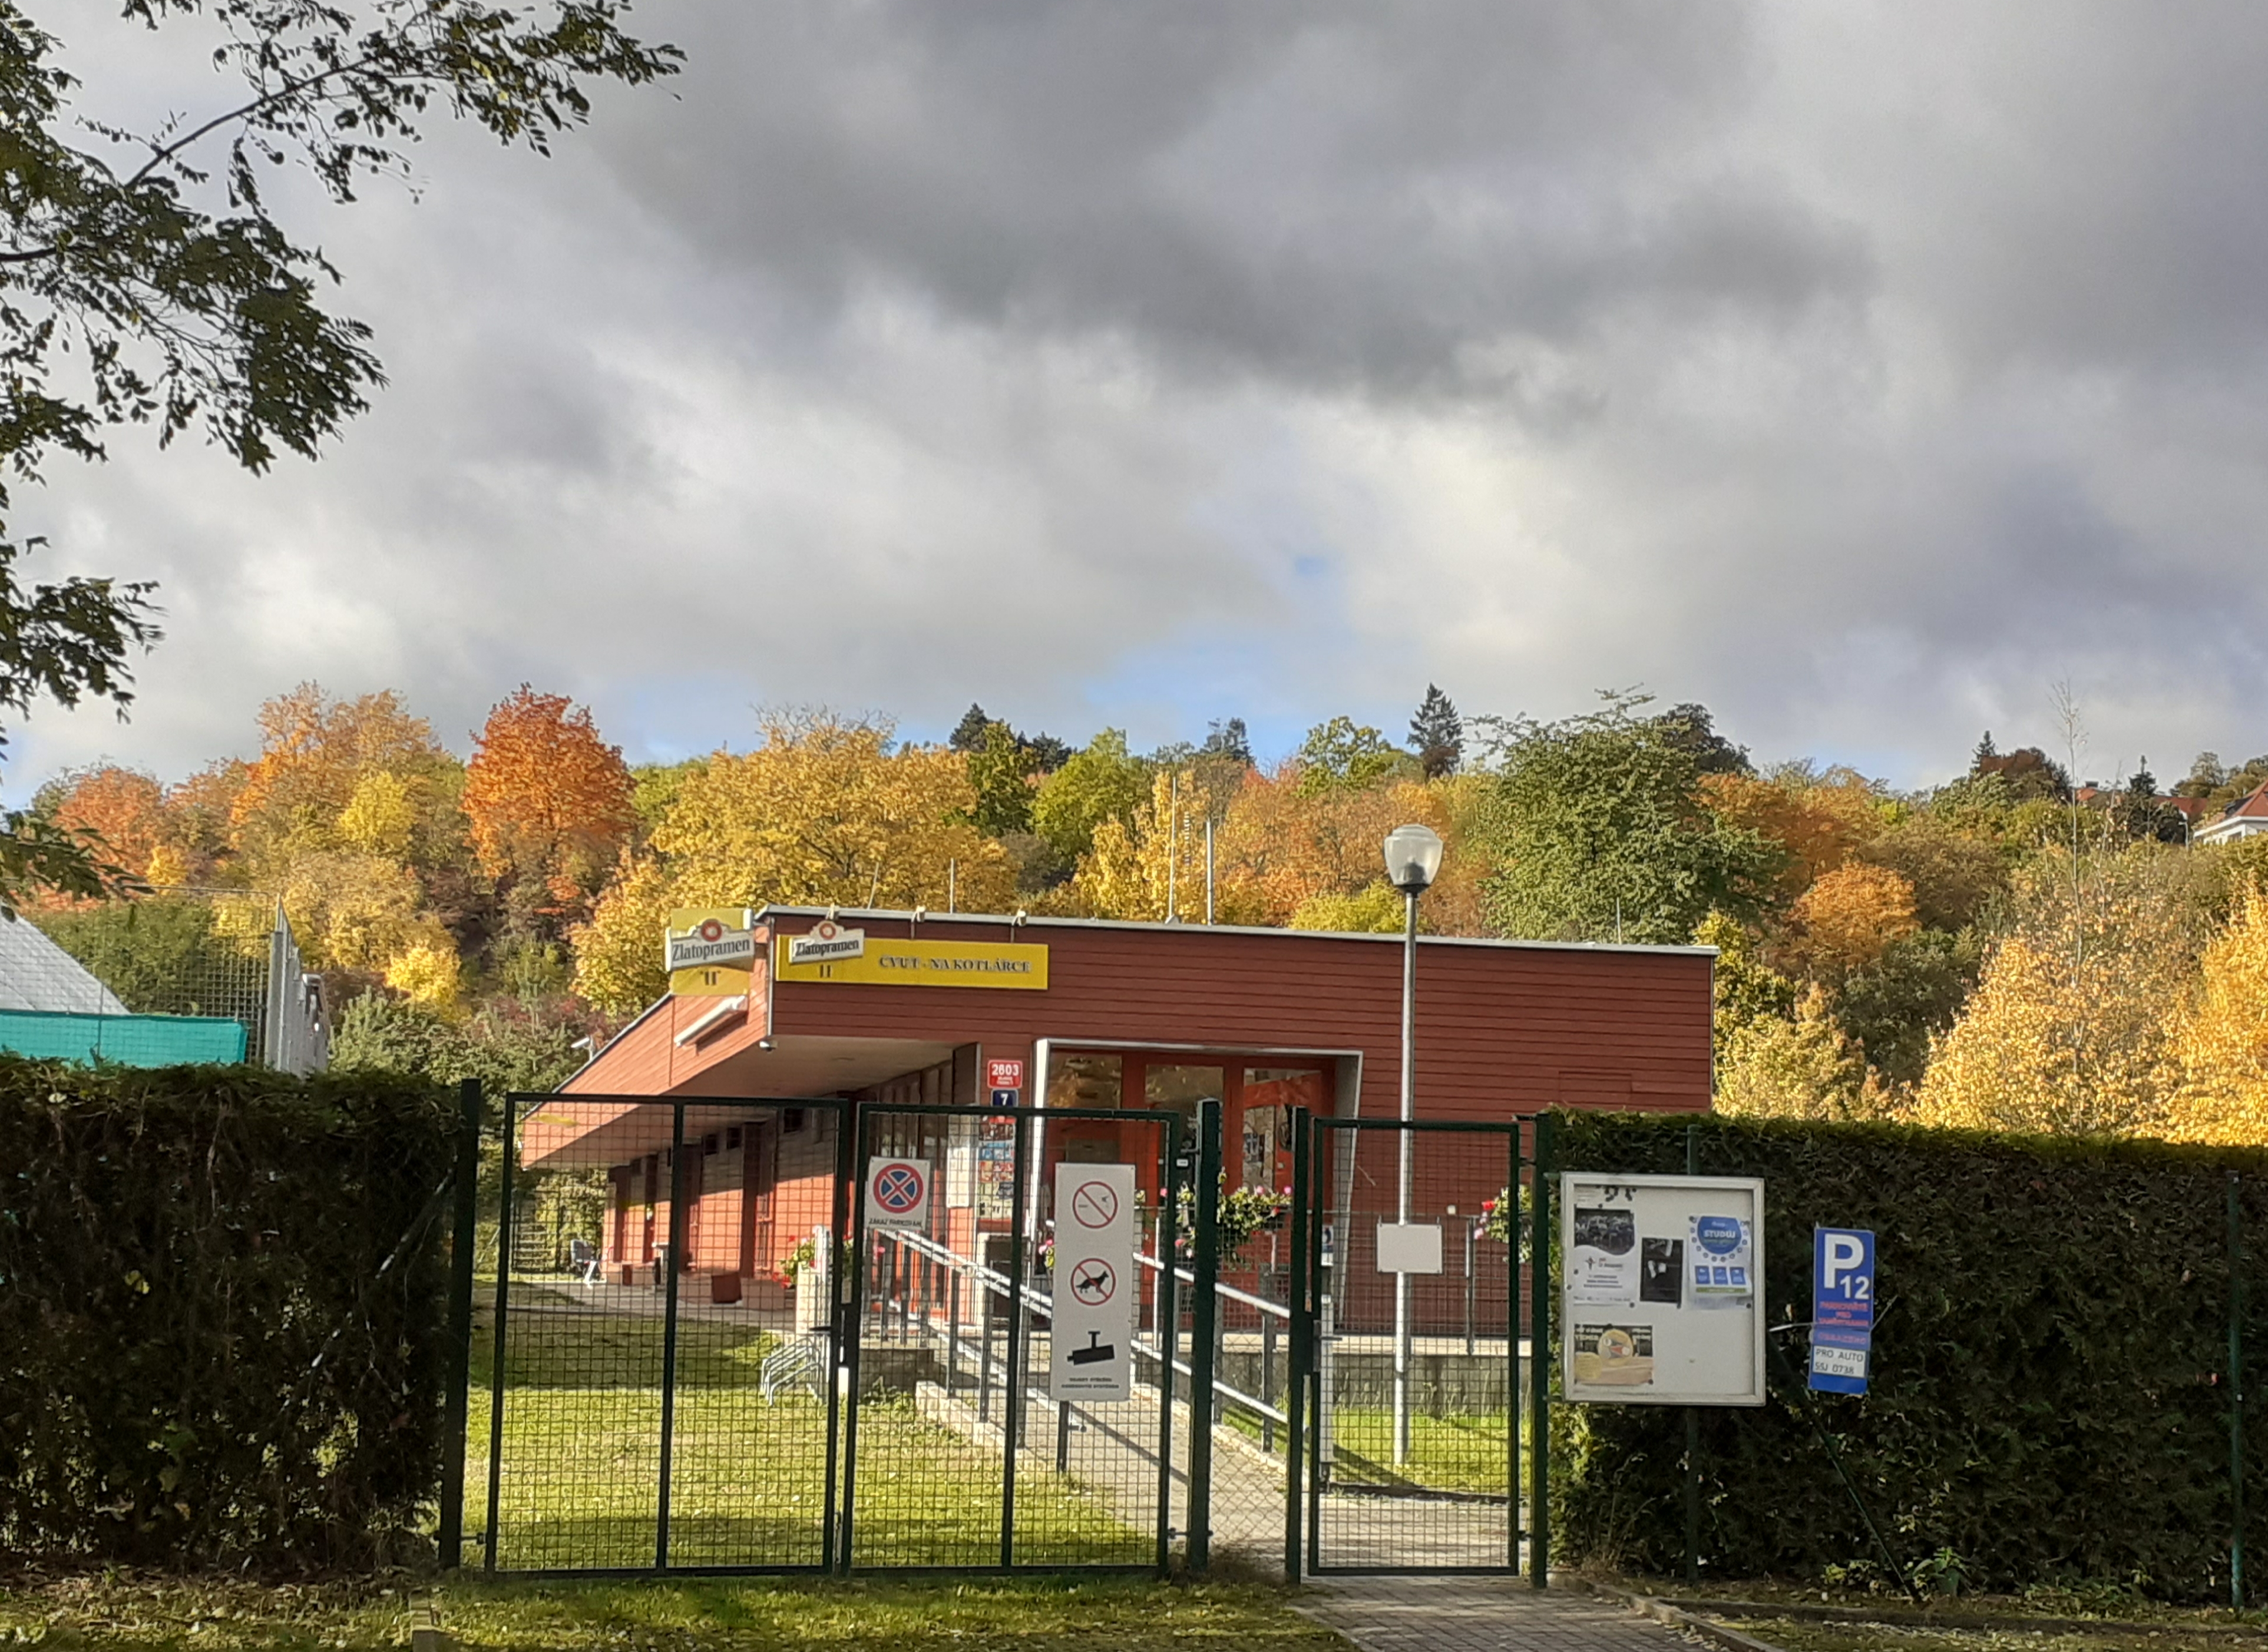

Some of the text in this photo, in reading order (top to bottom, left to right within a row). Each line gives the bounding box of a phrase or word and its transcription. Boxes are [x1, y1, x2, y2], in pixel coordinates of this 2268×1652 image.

[673, 939, 750, 961] Zlatopramen
[795, 939, 859, 956] Zlatopramen
[931, 958, 950, 970] NA
[1000, 1093, 1009, 1106] 7
[1816, 1348, 1864, 1362] PRO AUTO
